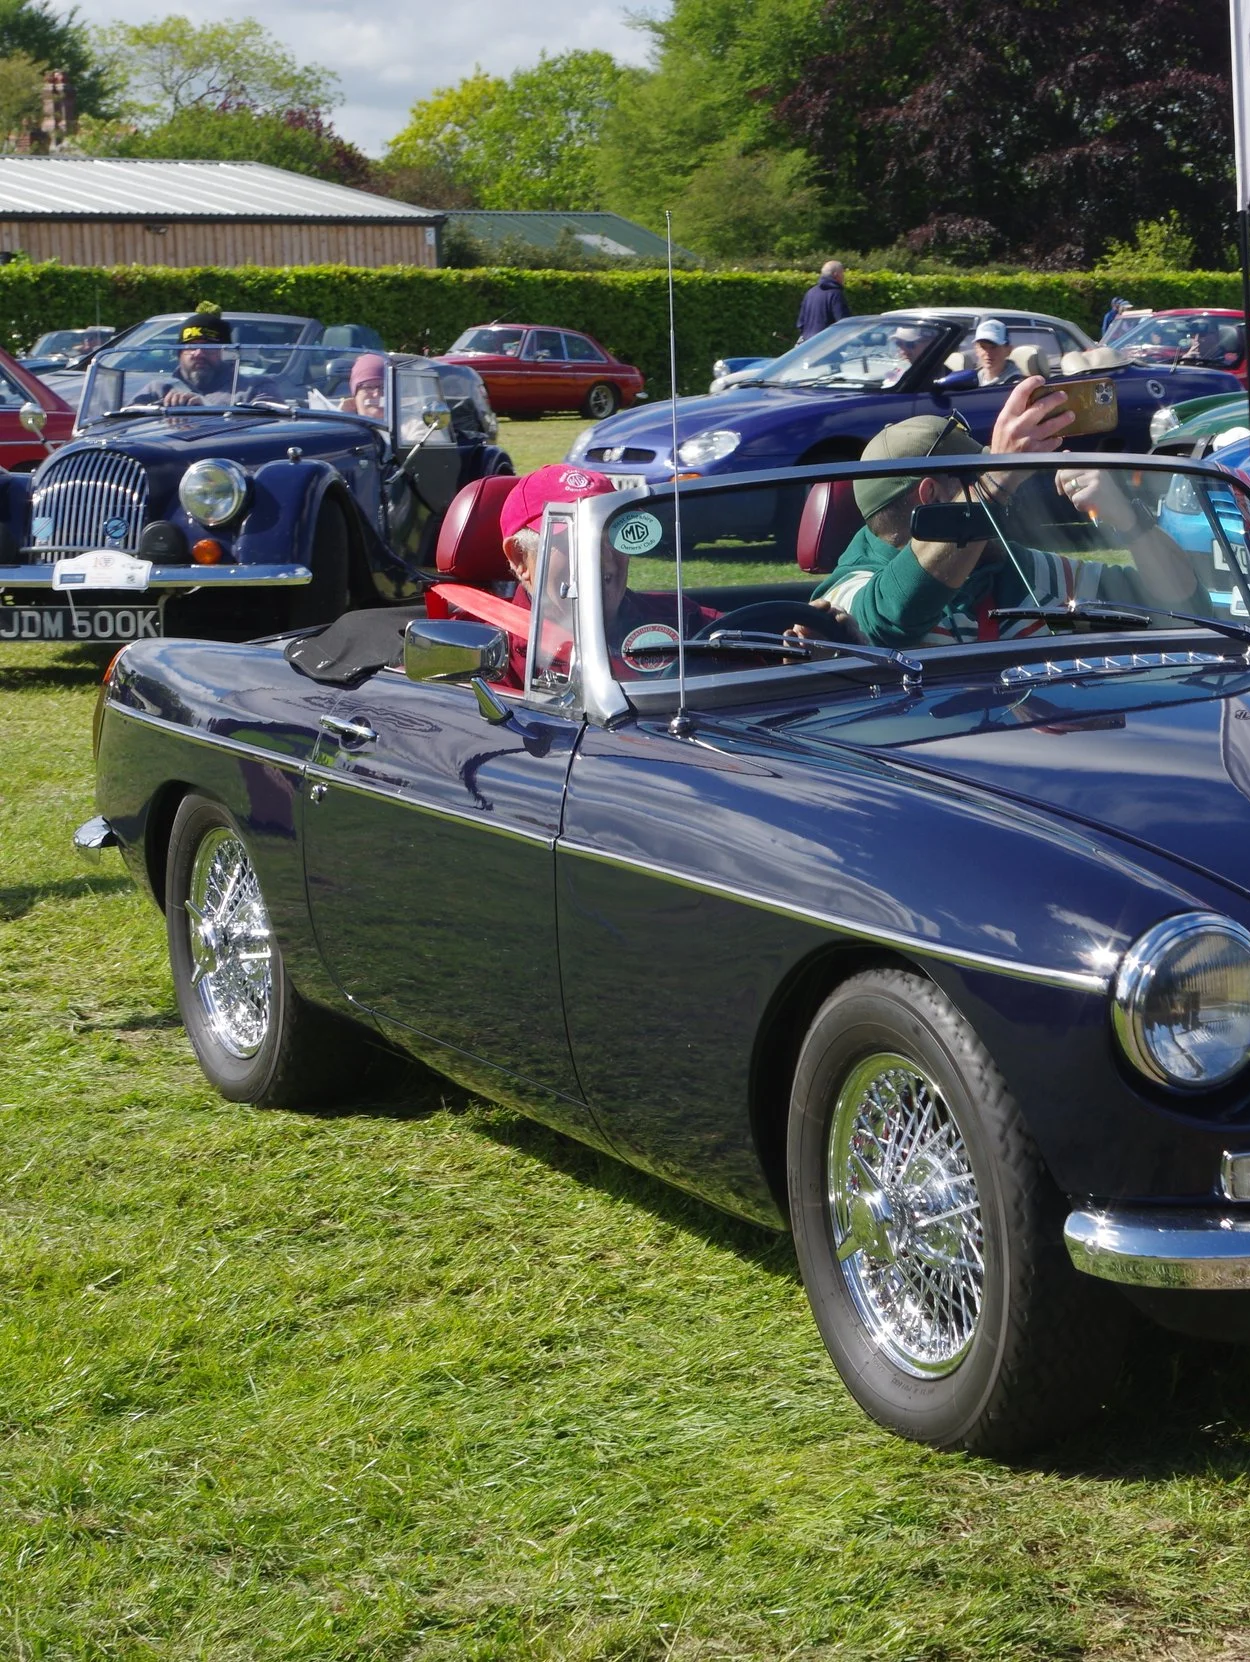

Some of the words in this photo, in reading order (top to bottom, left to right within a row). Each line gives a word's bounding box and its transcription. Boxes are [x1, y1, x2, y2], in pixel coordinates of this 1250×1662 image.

[623, 522, 647, 542] MG
[0, 611, 64, 638] JDM
[72, 610, 158, 638] 500K
